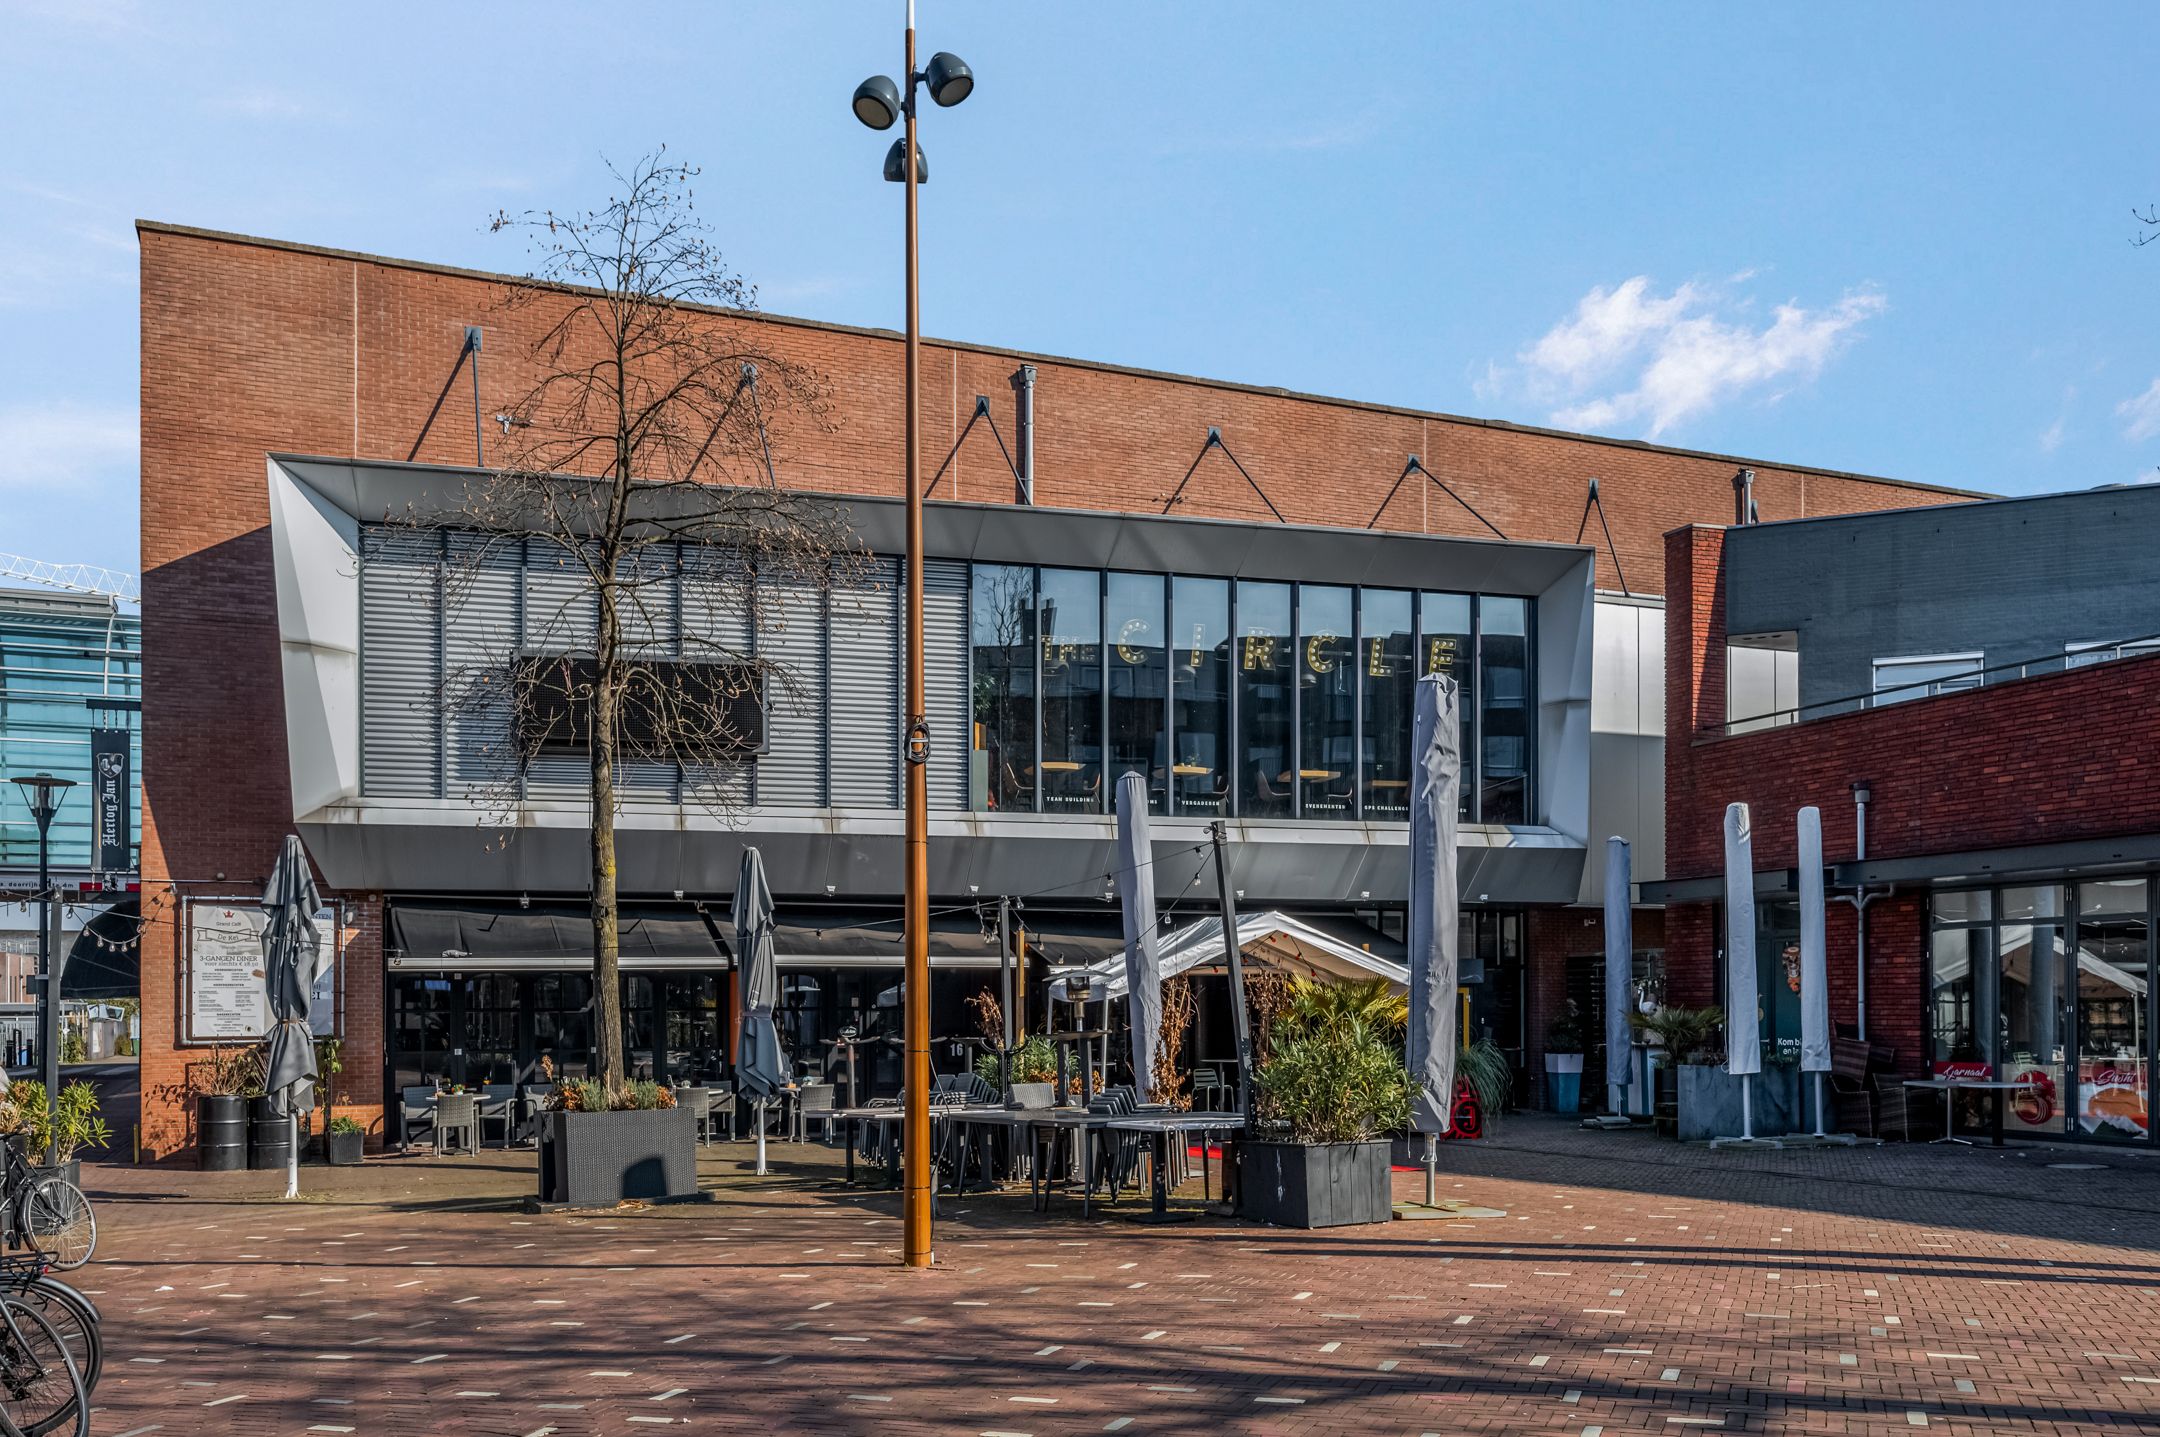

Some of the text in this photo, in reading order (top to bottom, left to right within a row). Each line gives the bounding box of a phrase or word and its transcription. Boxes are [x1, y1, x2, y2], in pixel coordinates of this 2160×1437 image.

[102, 779, 120, 847] Hertog Jan
[1777, 1037, 1793, 1046] Kom
[950, 1043, 964, 1057] 16
[1943, 1064, 1987, 1080] Garnaal
[2094, 1069, 2137, 1086] Sushi
